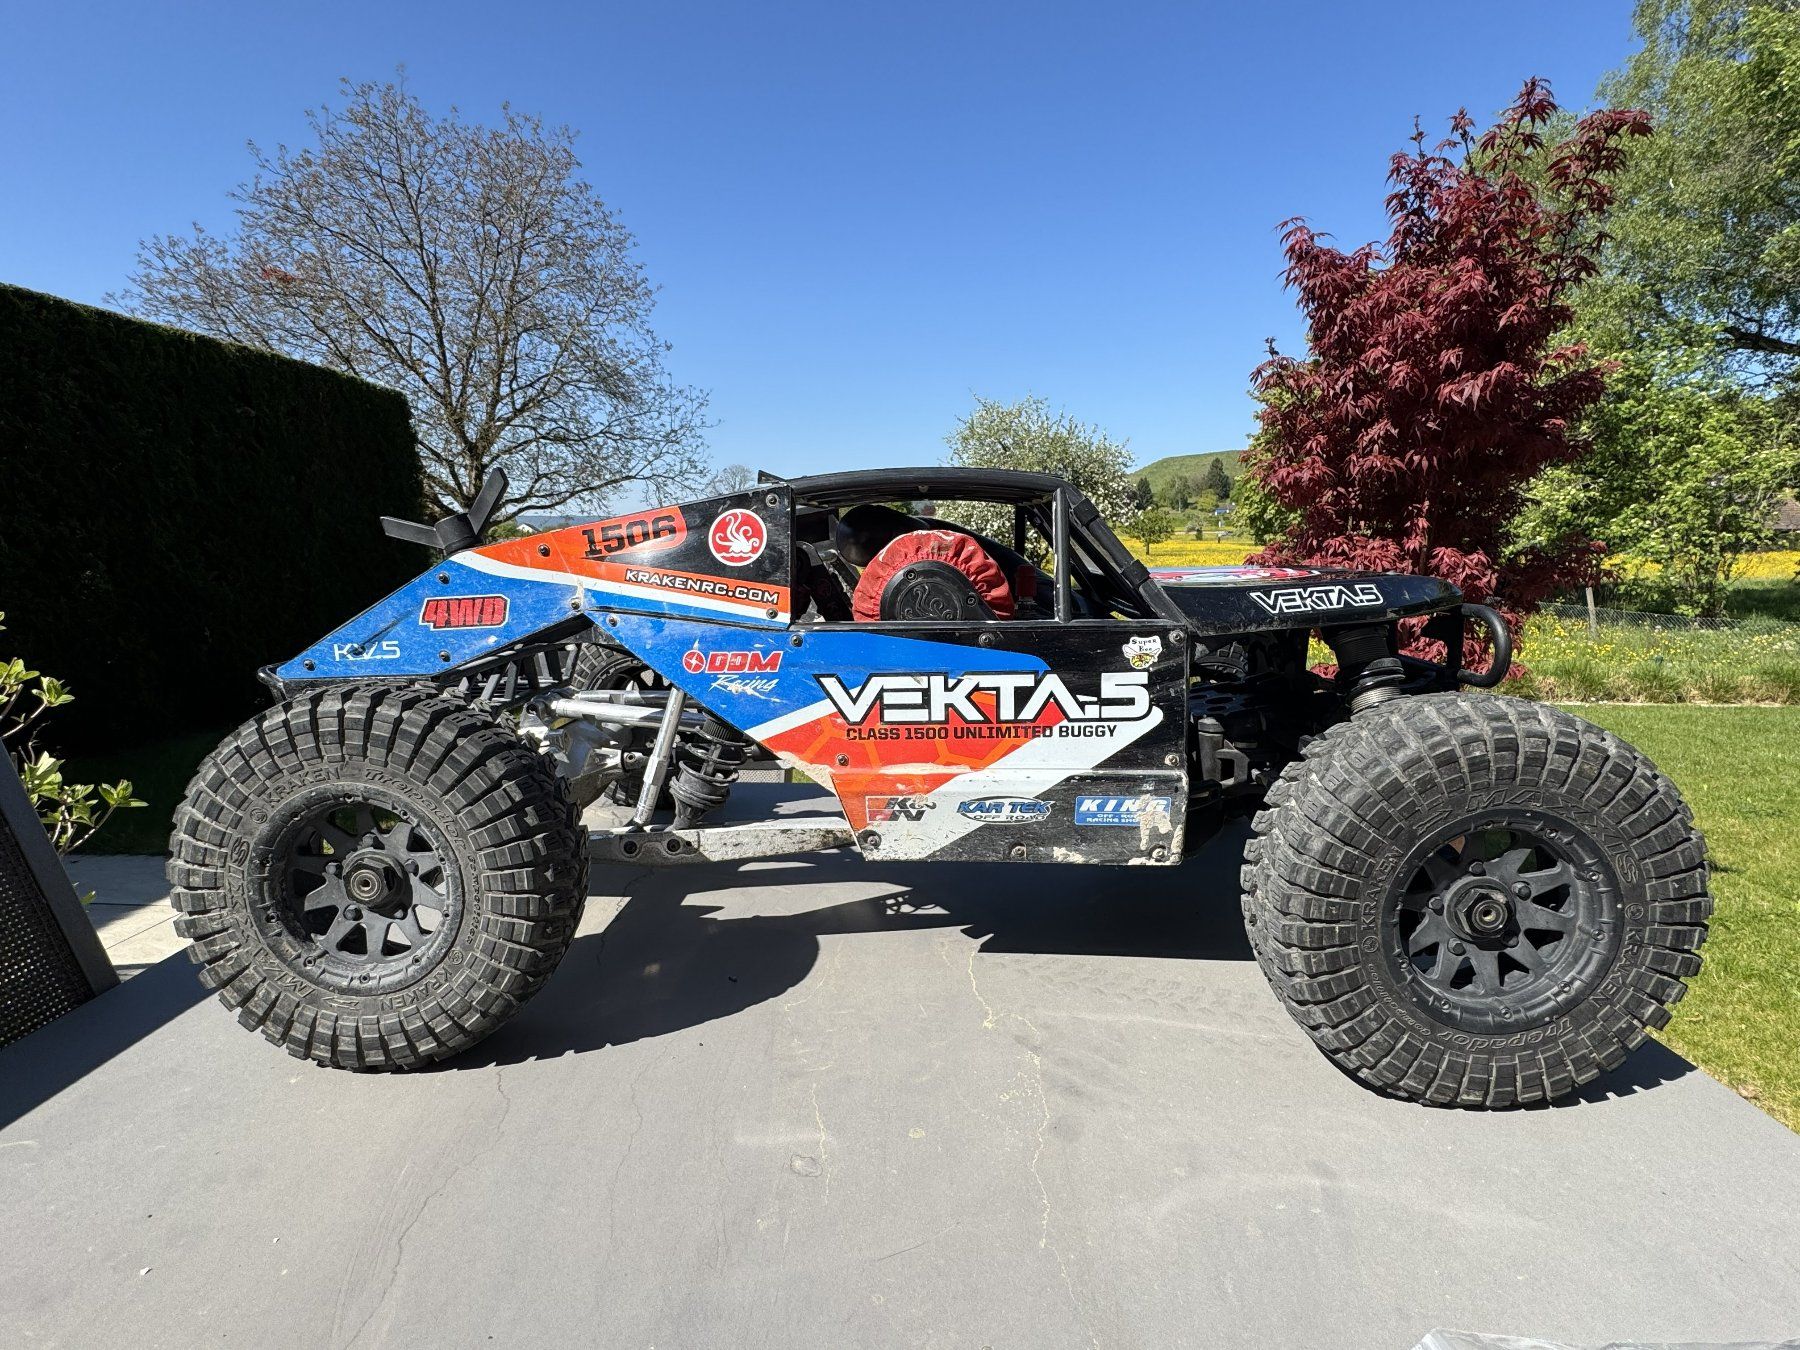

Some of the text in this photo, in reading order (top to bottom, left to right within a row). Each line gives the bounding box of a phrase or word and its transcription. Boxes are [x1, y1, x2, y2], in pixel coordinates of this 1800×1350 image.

[582, 514, 677, 557] 1506
[625, 569, 778, 604] KRAKENRC.COM
[422, 596, 507, 629] 4WD
[705, 651, 784, 673] DDM
[846, 724, 1118, 741] CLASS 1500 UNLIMITED BUGGY
[263, 766, 341, 809] KRAKEN
[1079, 798, 1169, 812] KING
[364, 769, 467, 851] Trepador
[1466, 788, 1640, 885] MAXXIS
[1361, 846, 1404, 930] KRAKEN
[1590, 926, 1643, 1006] KRAKEN
[379, 966, 454, 1012] KRAKEN
[1437, 1017, 1574, 1051] Trepador
